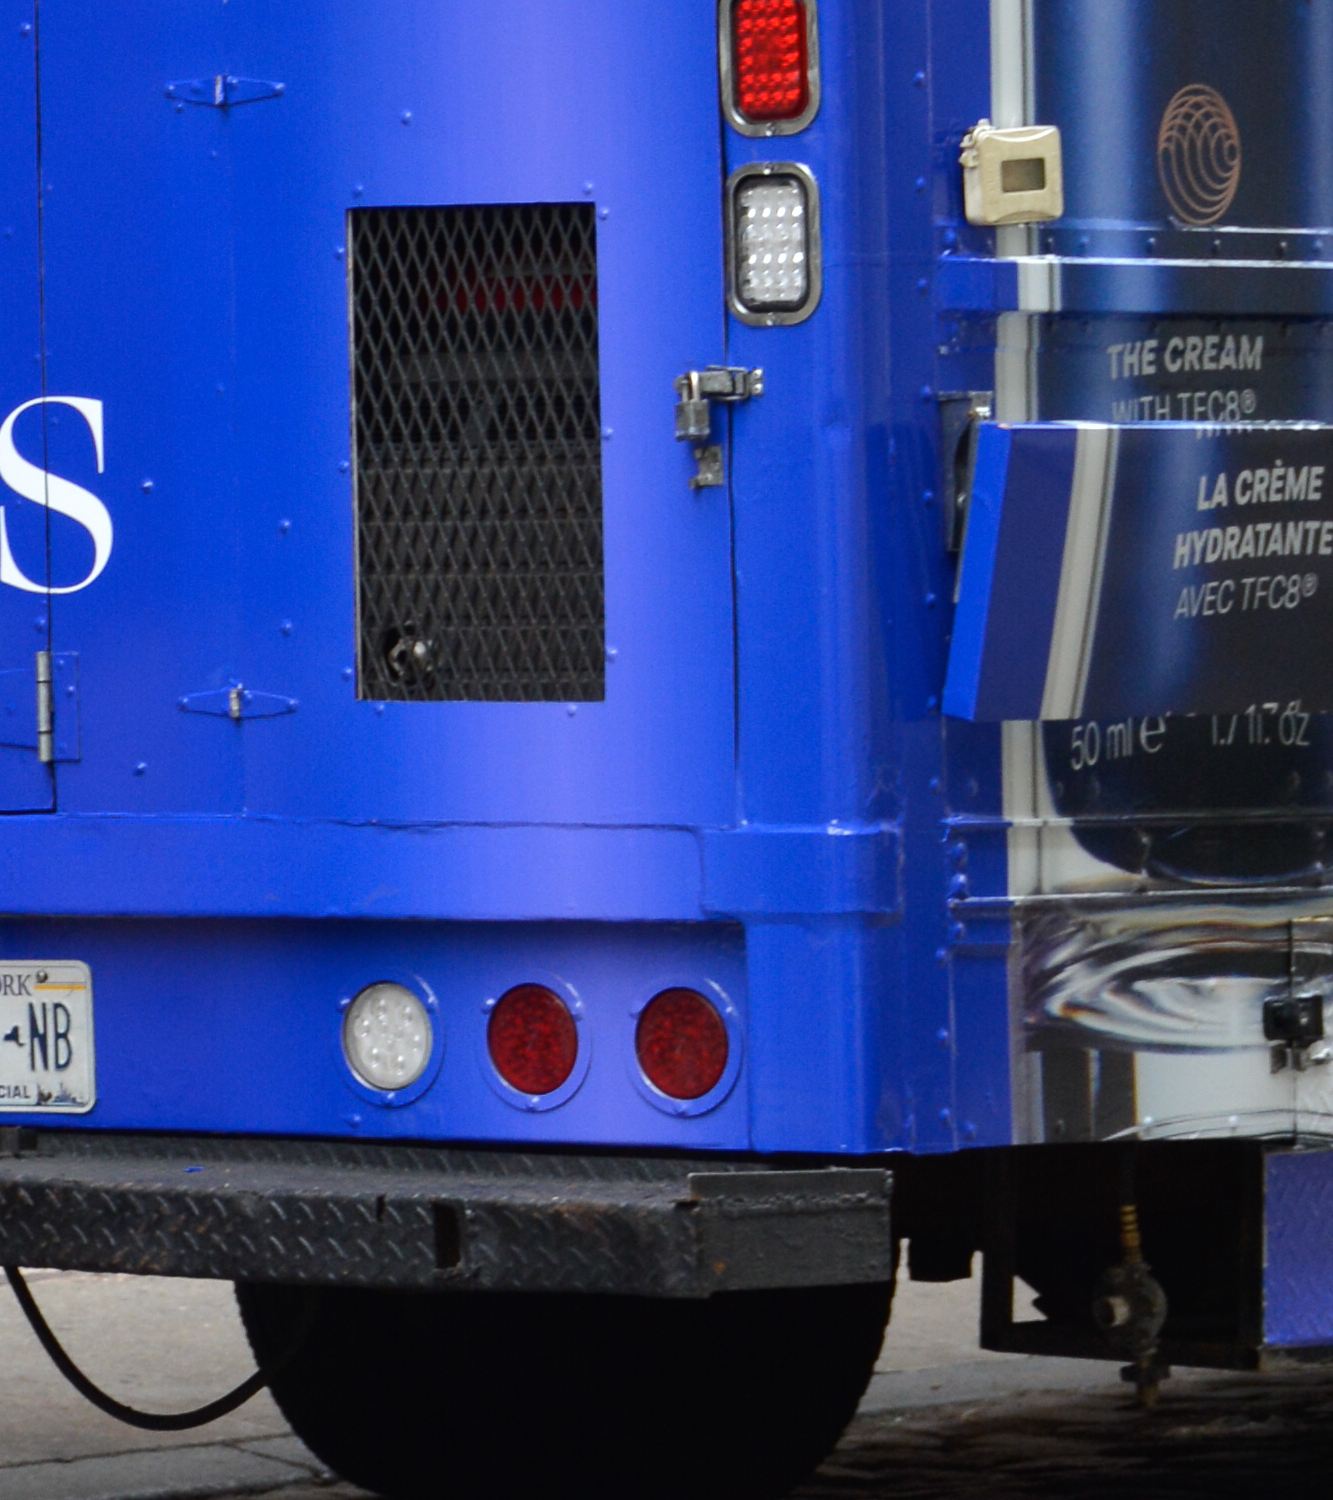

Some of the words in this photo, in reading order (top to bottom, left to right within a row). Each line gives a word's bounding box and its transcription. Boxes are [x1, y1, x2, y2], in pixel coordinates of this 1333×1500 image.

[1106, 339, 1159, 381] THE
[1164, 334, 1265, 374] CREAM
[1111, 394, 1171, 422] WITH
[1196, 472, 1229, 513] LA
[1234, 458, 1326, 506] CRÈME
[1172, 520, 1333, 571] HYDRATANTE
[1173, 579, 1236, 621] AVEC
[1070, 720, 1101, 771] 50
[1106, 716, 1134, 760] ml
[28, 1002, 73, 1072] NB
